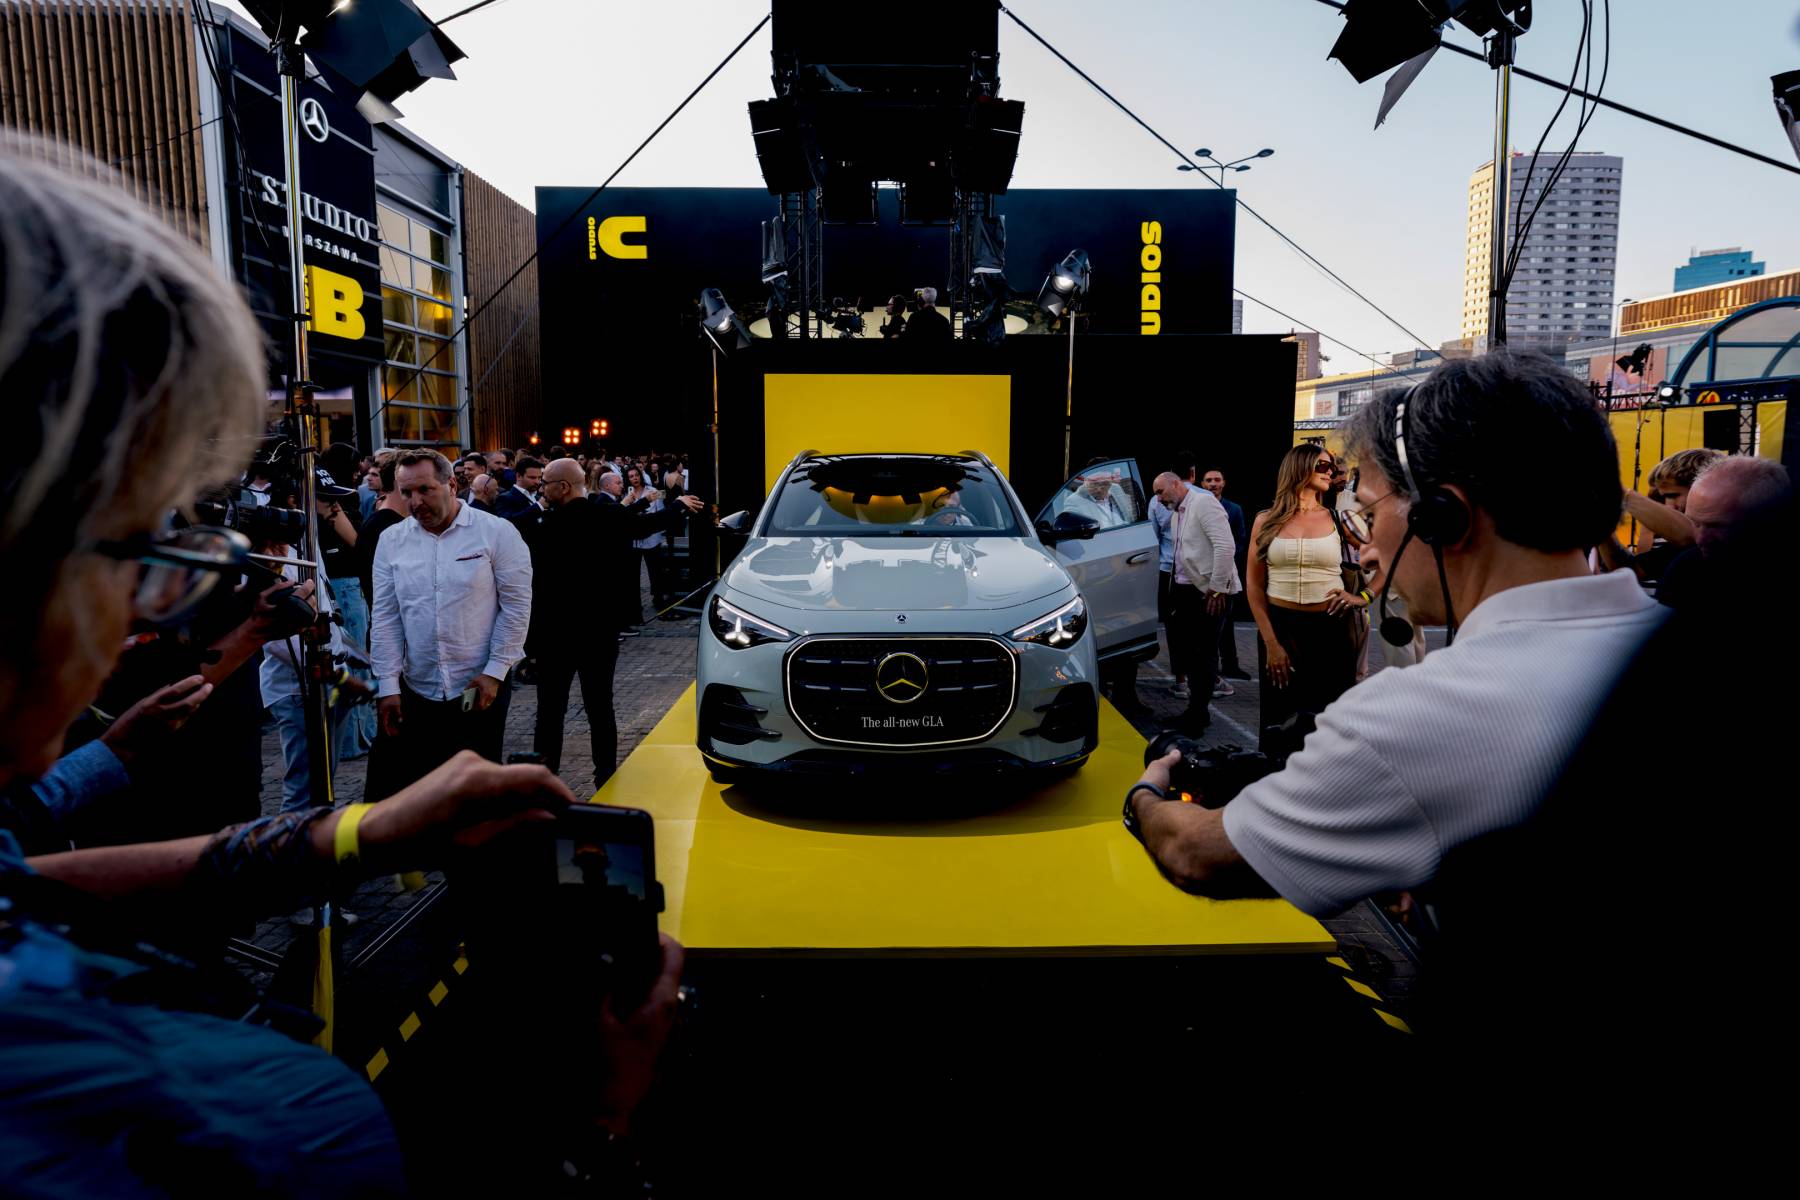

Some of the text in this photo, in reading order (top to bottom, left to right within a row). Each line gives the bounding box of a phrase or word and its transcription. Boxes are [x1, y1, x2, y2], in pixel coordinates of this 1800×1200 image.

[282, 225, 359, 263] RSZAWA
[588, 216, 597, 260] STUDIO
[307, 265, 366, 340] B
[861, 715, 944, 728] The all-new GLA
